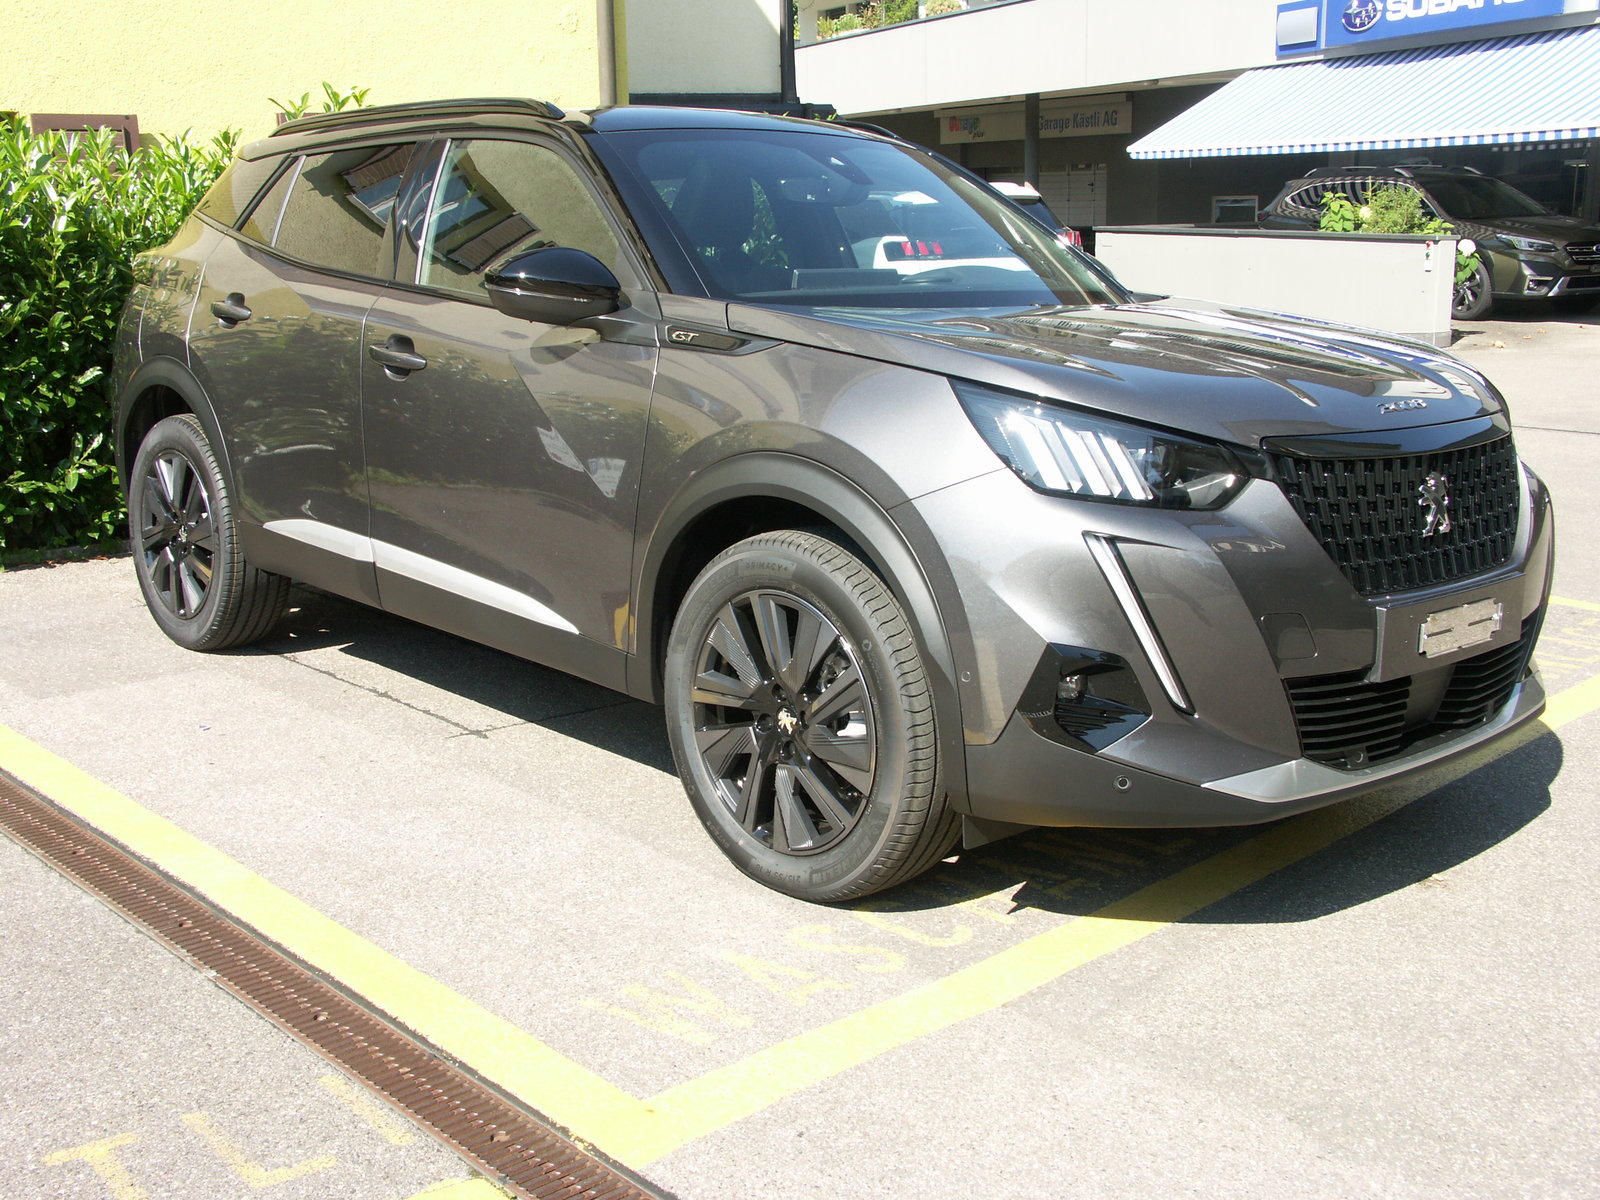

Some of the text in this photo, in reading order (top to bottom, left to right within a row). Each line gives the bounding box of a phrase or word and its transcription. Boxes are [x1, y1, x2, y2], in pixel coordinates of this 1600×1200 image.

[1038, 110, 1118, 133] Garage Kästli AG
[671, 330, 700, 342] GT
